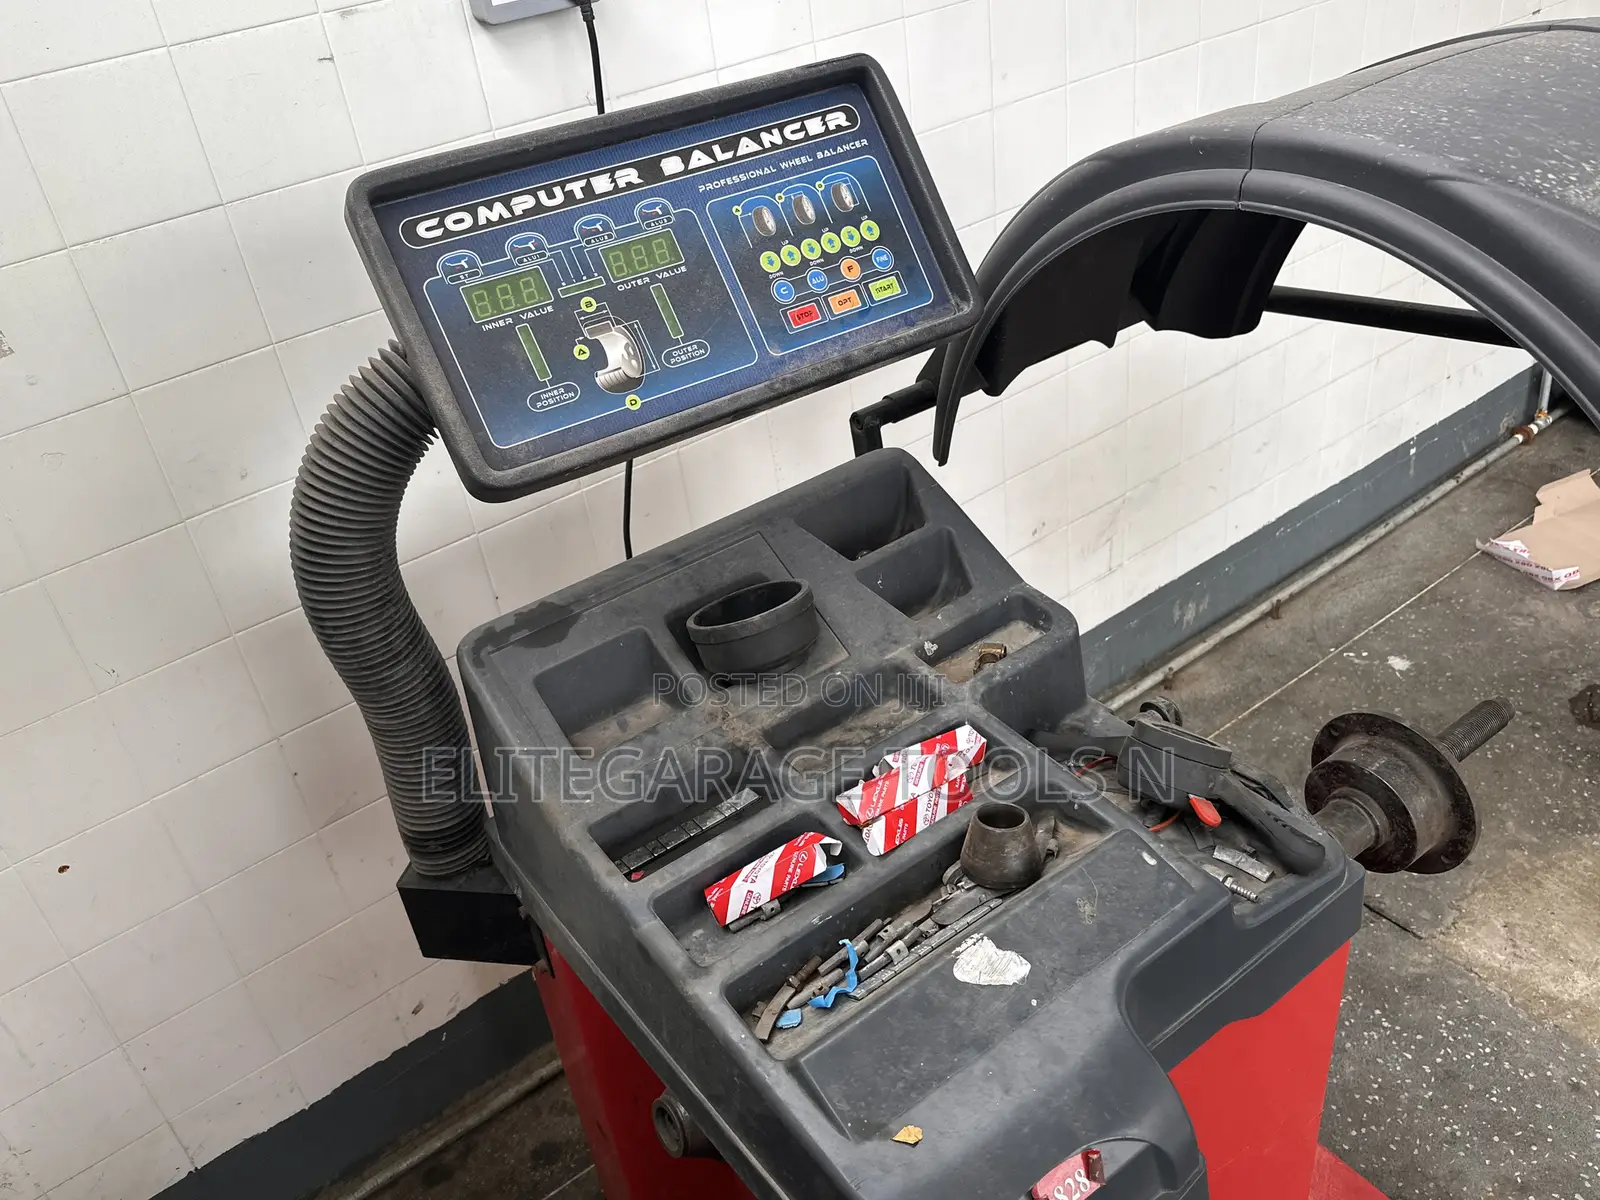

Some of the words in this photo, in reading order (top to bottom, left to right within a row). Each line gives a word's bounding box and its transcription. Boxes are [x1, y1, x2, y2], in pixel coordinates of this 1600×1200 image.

[698, 164, 777, 193] PROFESSIONAL
[779, 155, 813, 171] WHEEL
[816, 138, 869, 160] BALANCER
[416, 167, 644, 239] COMPUTER
[660, 111, 852, 176] BALANCER
[849, 245, 864, 254] DOWN
[809, 258, 825, 267] DOWN
[876, 253, 889, 263] FINE
[769, 271, 784, 279] DOWN
[847, 264, 854, 273] F
[617, 277, 651, 292] OUTER
[655, 265, 687, 280] VALUE
[811, 274, 825, 285] ALU
[780, 286, 789, 295] C
[481, 317, 514, 332] INNER
[519, 305, 555, 320] VALUE
[670, 348, 705, 364] POSITION
[672, 344, 698, 357] OUTER
[536, 390, 575, 409] POSITION
[540, 387, 565, 400] INNER
